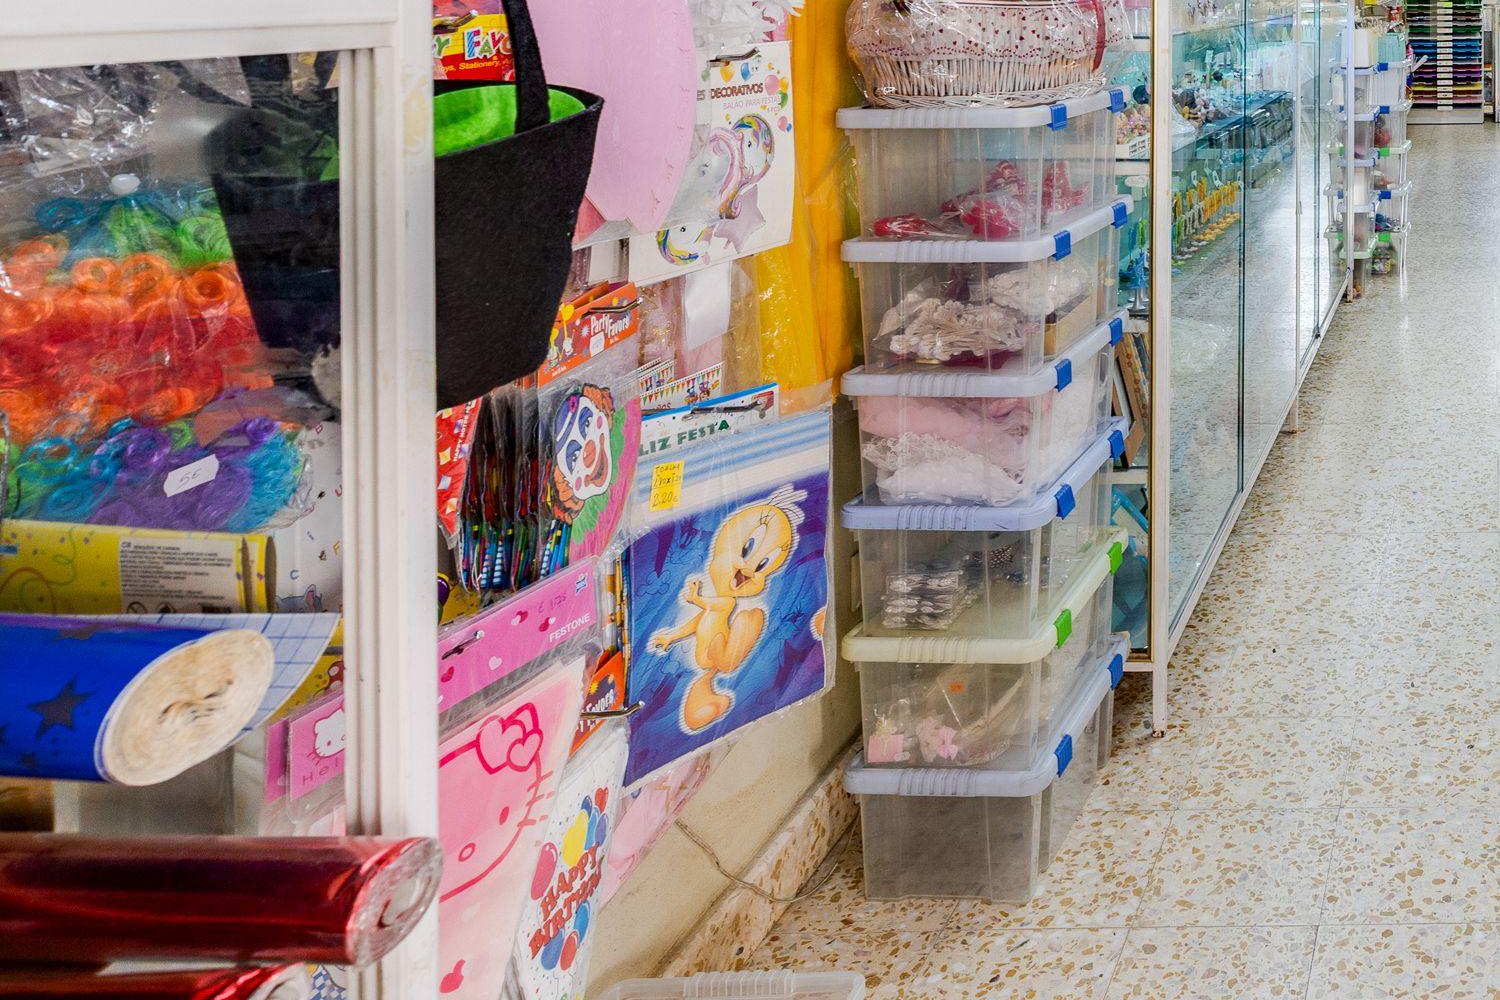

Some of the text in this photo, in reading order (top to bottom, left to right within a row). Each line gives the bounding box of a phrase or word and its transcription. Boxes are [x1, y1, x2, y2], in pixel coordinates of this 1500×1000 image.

[710, 82, 764, 100] DECORATIVOS
[677, 419, 730, 445] FESTA
[549, 613, 591, 642] FESTONE
[302, 757, 340, 785] Hel
[541, 842, 600, 921] HAPPY
